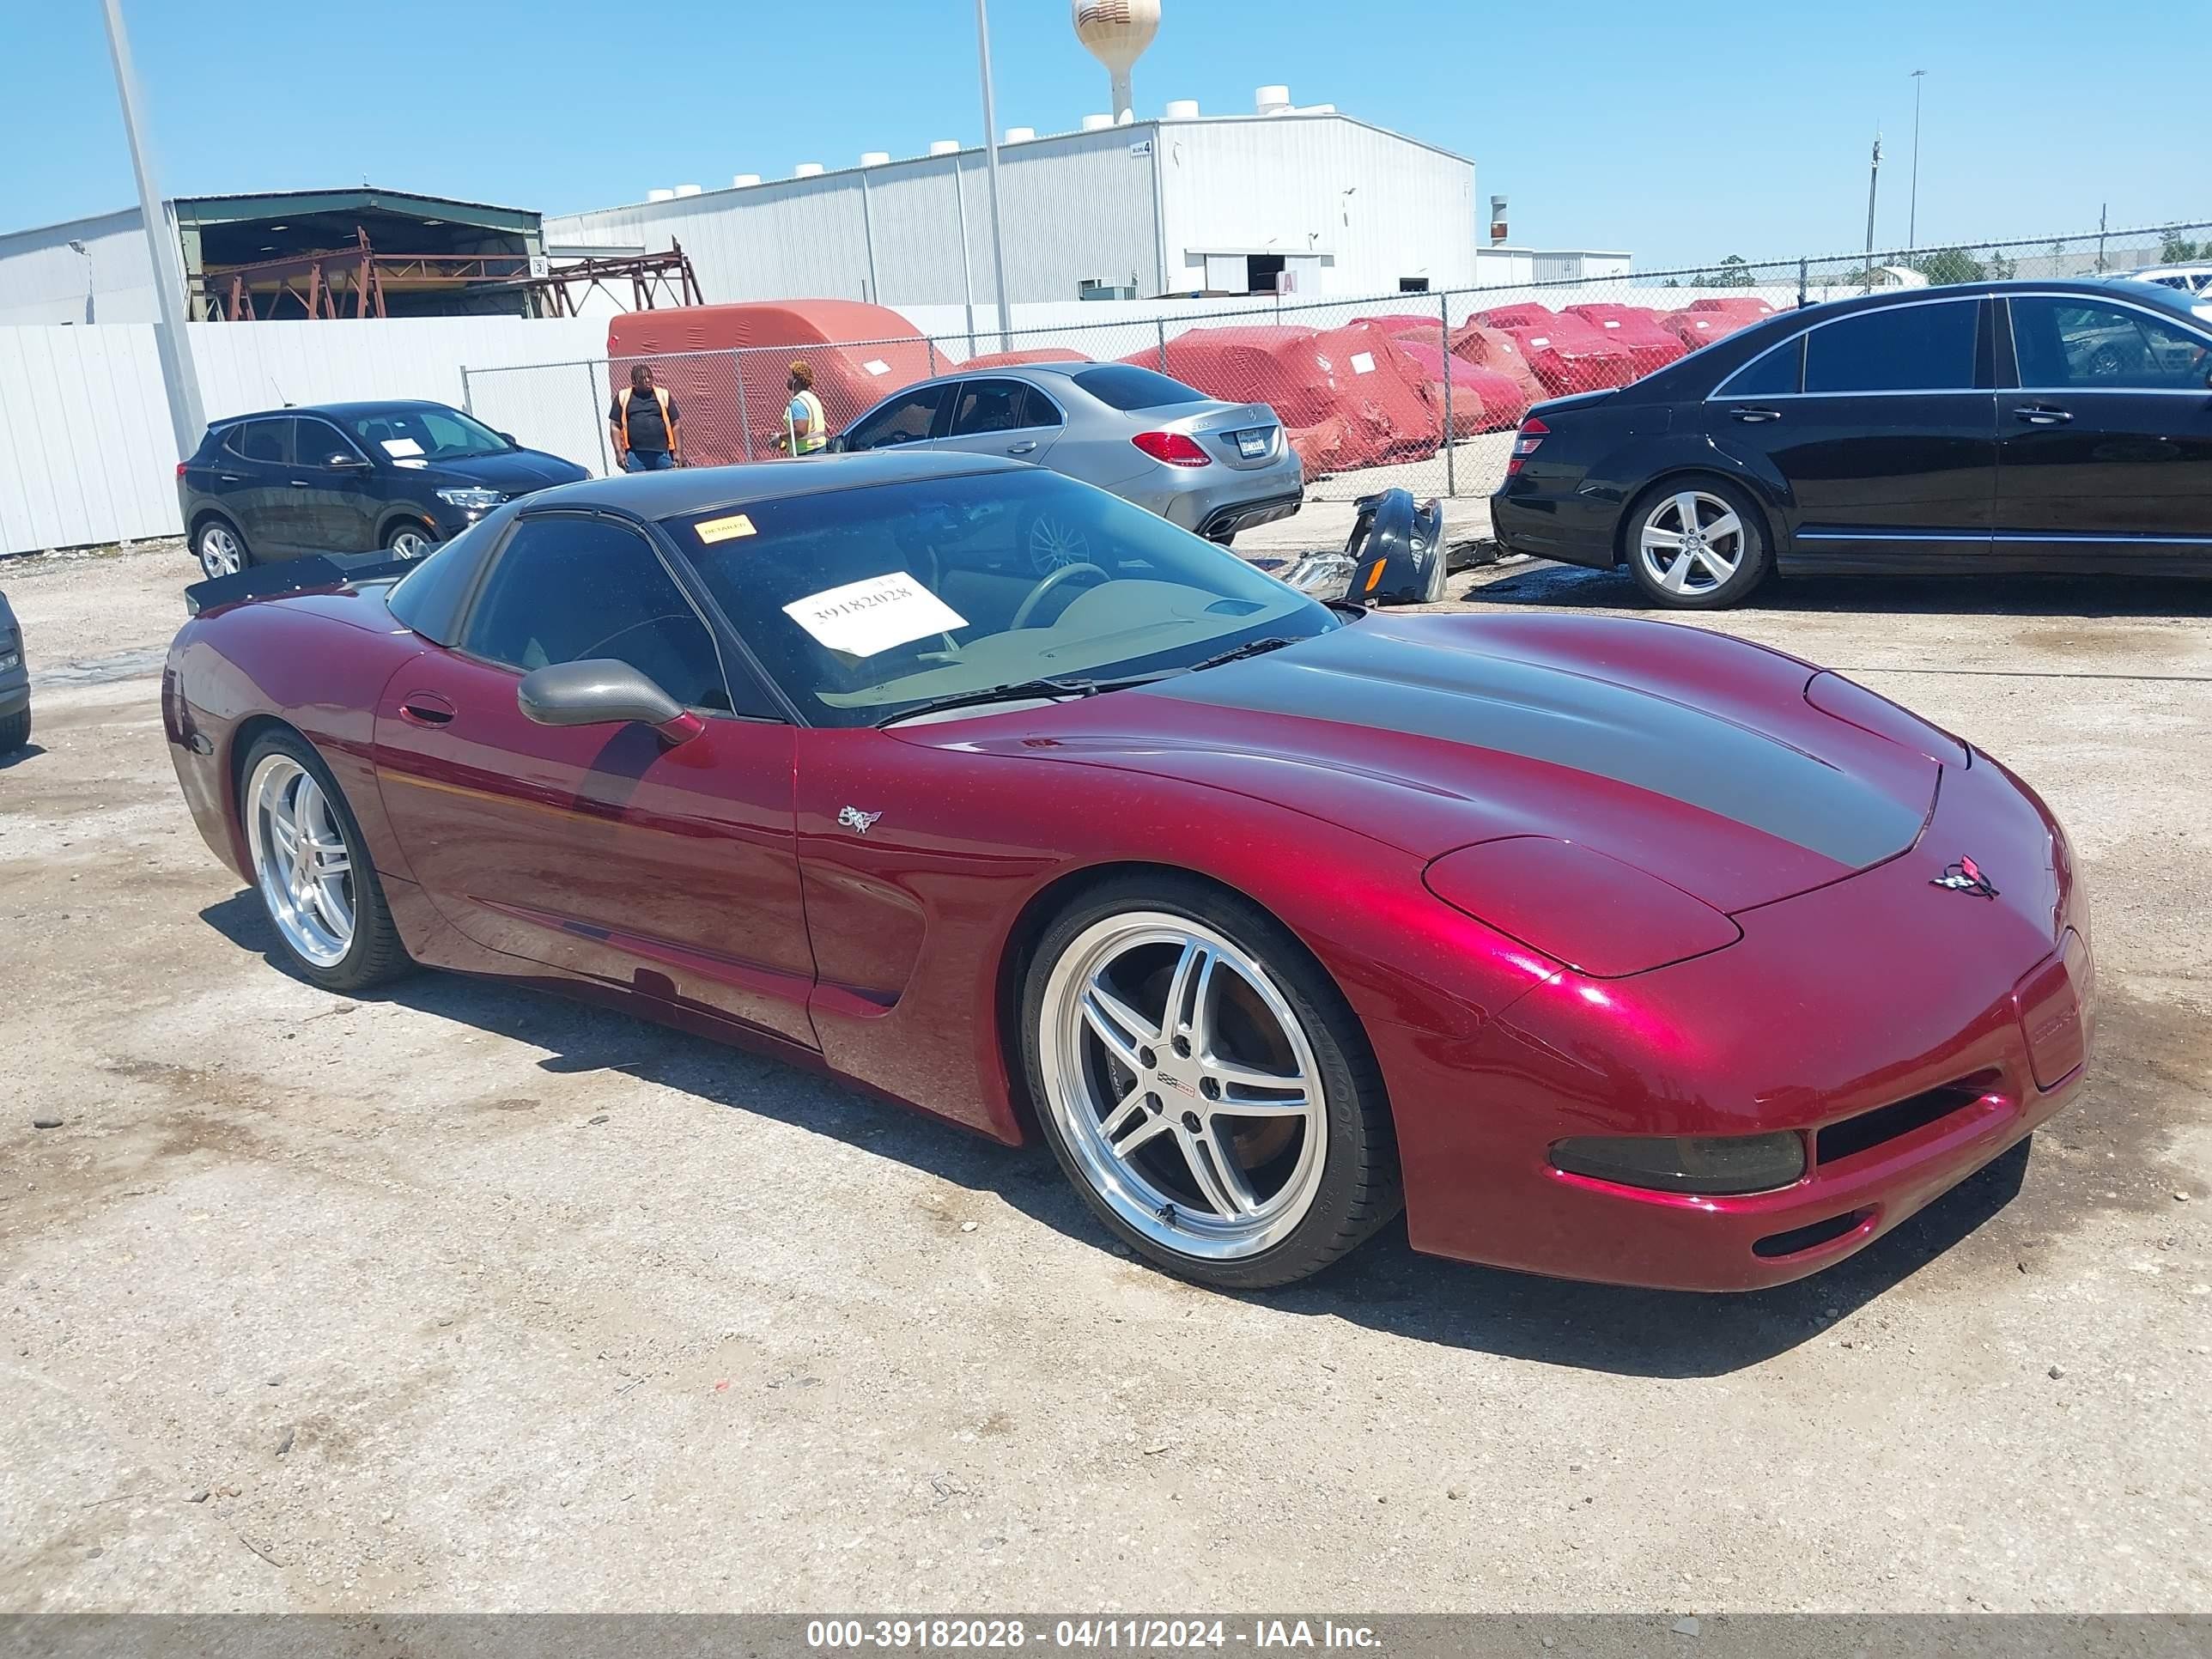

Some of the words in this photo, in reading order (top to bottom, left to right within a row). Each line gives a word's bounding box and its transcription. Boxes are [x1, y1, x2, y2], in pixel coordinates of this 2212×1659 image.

[1144, 142, 1151, 153] 4
[1284, 273, 1293, 292] A
[704, 522, 746, 534] DETAILED
[812, 586, 913, 624] 39182028
